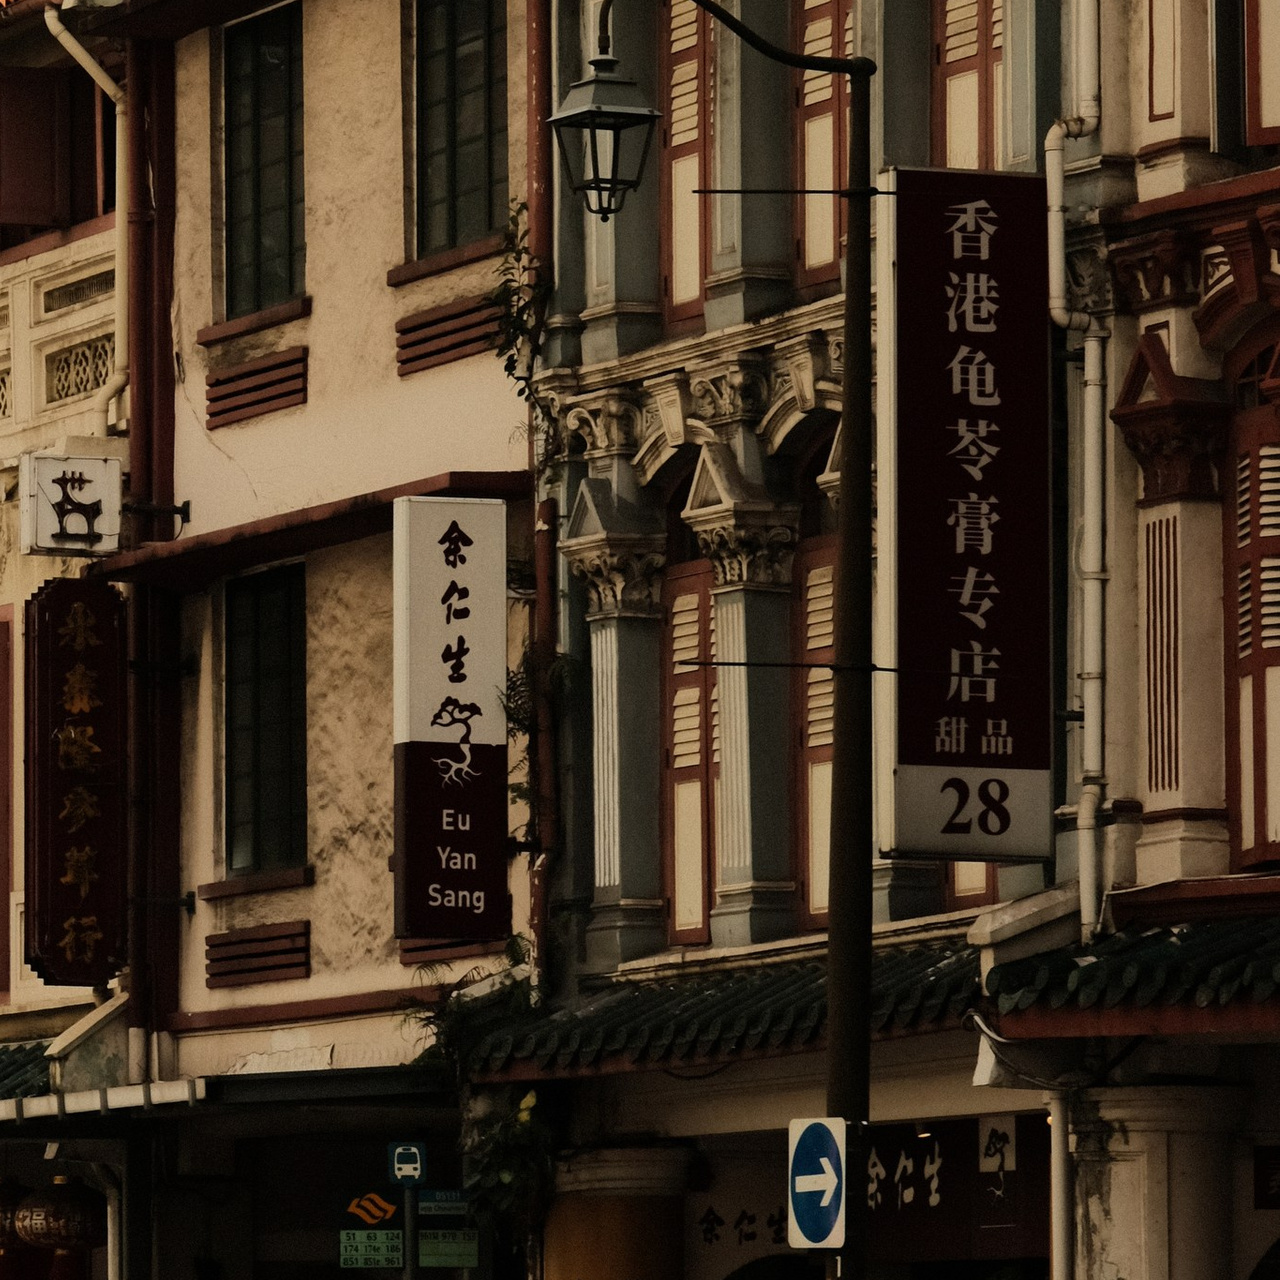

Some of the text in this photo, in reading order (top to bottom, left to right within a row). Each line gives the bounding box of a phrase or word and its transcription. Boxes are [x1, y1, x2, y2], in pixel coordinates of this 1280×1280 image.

[944, 199, 1001, 704] 香港龟苓膏专店
[438, 520, 474, 684] 余仁生
[934, 716, 1013, 755] 甜品
[442, 809, 470, 831] Eu
[940, 777, 1011, 836] 28
[436, 846, 477, 870] Yan
[428, 883, 485, 914] Sang
[344, 1244, 359, 1253] 174
[346, 1232, 356, 1241] 51
[366, 1232, 377, 1241] 63
[385, 1232, 400, 1241] 124
[343, 1257, 359, 1266] 851
[385, 1257, 400, 1266] 961
